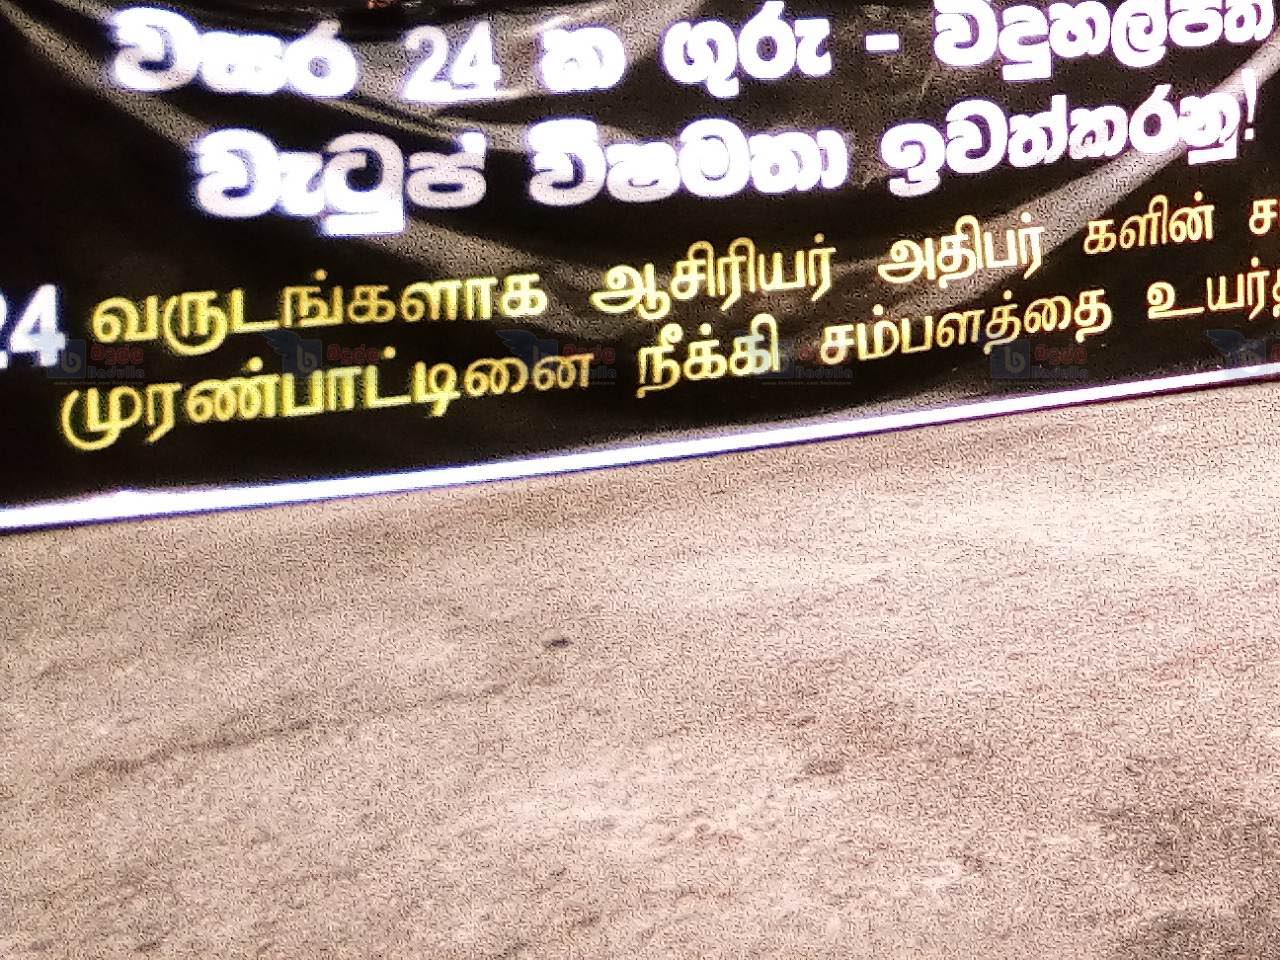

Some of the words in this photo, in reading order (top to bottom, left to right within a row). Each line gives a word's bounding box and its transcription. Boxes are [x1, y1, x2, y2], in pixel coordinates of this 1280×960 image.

[111, 6, 359, 99] වසර
[403, 25, 503, 103] 24
[538, 21, 627, 90] ක
[661, 1, 832, 98] ගුරු
[192, 127, 487, 235] වැටුප්
[524, 117, 848, 205] විෂමතා
[92, 268, 548, 355] வருடங்களாக
[590, 234, 836, 321] ஆசிரியர்
[878, 211, 1050, 289] அதிபர்
[1082, 191, 1216, 256] களின்
[61, 345, 595, 451] முரண்பாட்டினை
[637, 315, 779, 397] நீக்கி
[821, 288, 1112, 366] சம்பளத்தை
